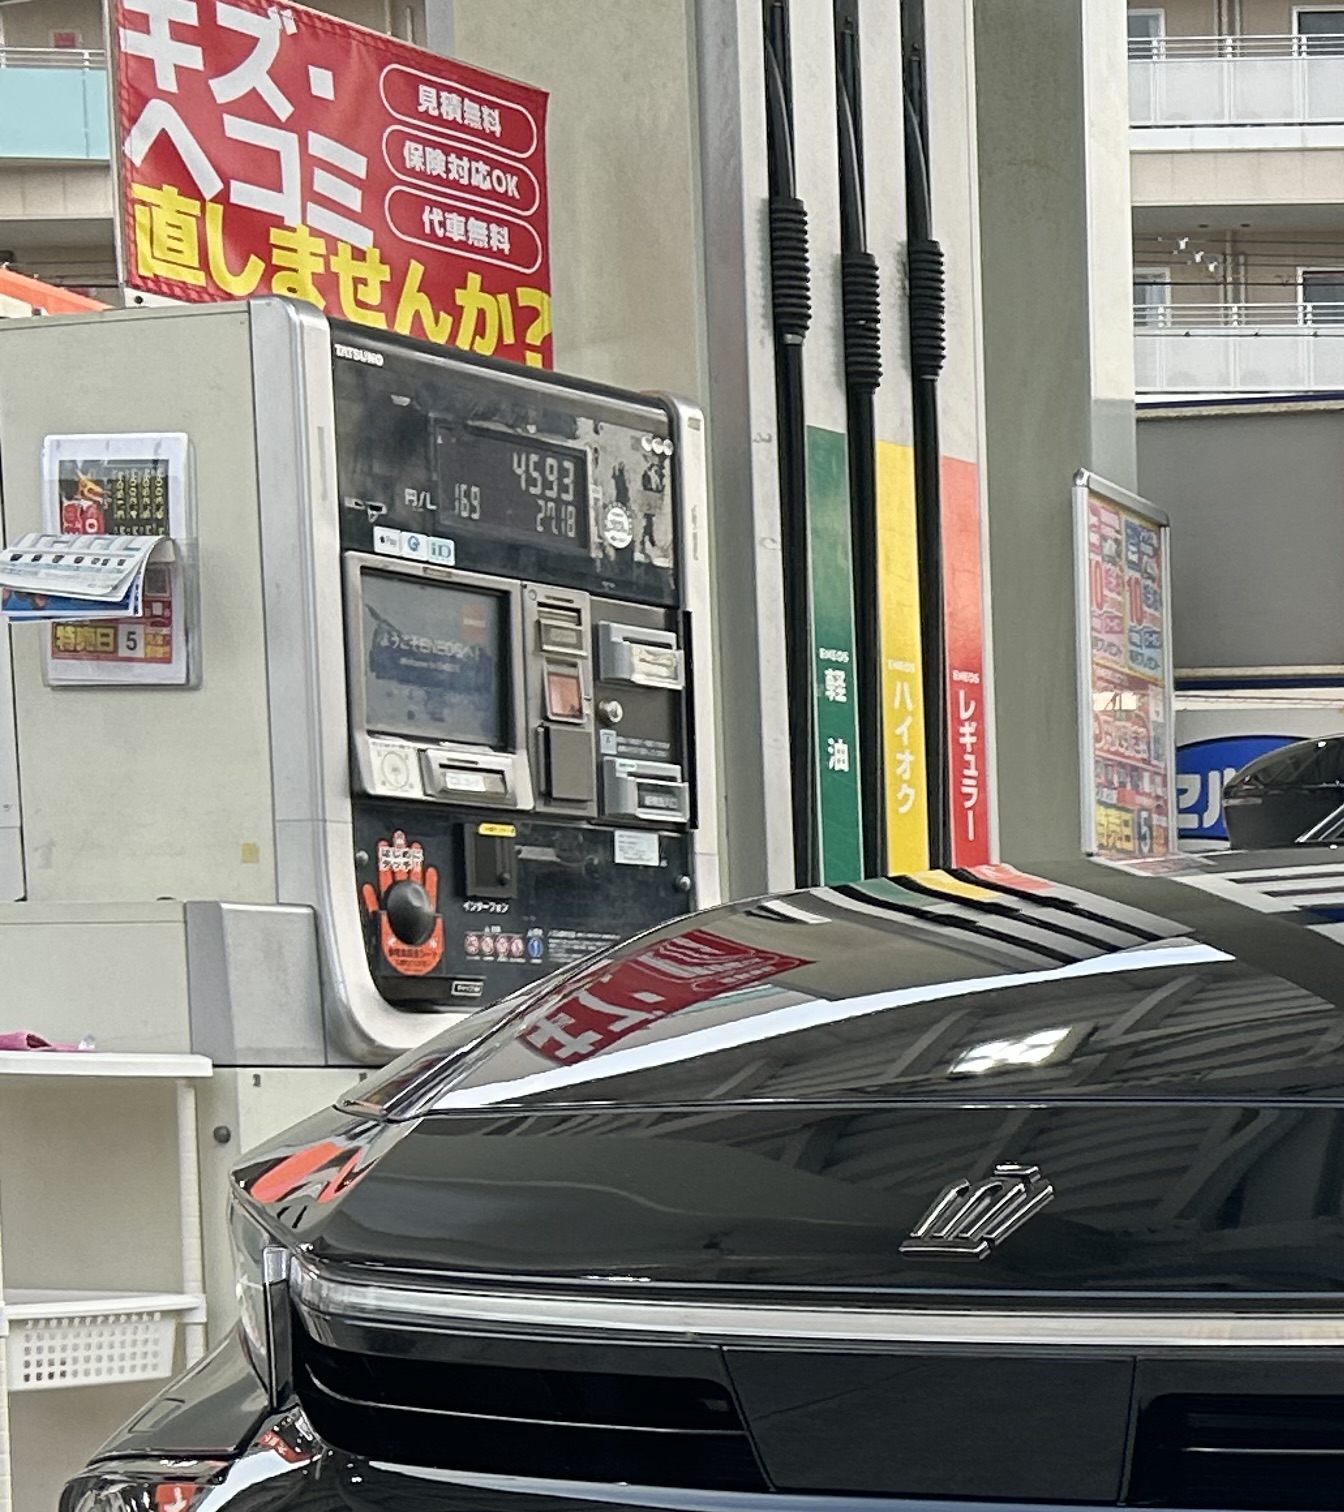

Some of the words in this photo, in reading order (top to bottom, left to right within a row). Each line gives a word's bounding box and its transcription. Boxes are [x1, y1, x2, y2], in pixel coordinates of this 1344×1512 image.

[416, 84, 502, 138] 見積無料
[124, 98, 376, 250] ヘコミ
[403, 138, 520, 200] 保険対応OK
[421, 204, 511, 255] 代車無料
[334, 343, 384, 367] TATSUNO
[512, 451, 575, 501] 4593
[455, 483, 480, 520] 169
[126, 630, 138, 651] 5
[819, 648, 850, 664] ENEOS
[952, 669, 980, 684] ENEOS
[893, 680, 916, 814] ハイオク
[958, 688, 979, 842] レギュラー
